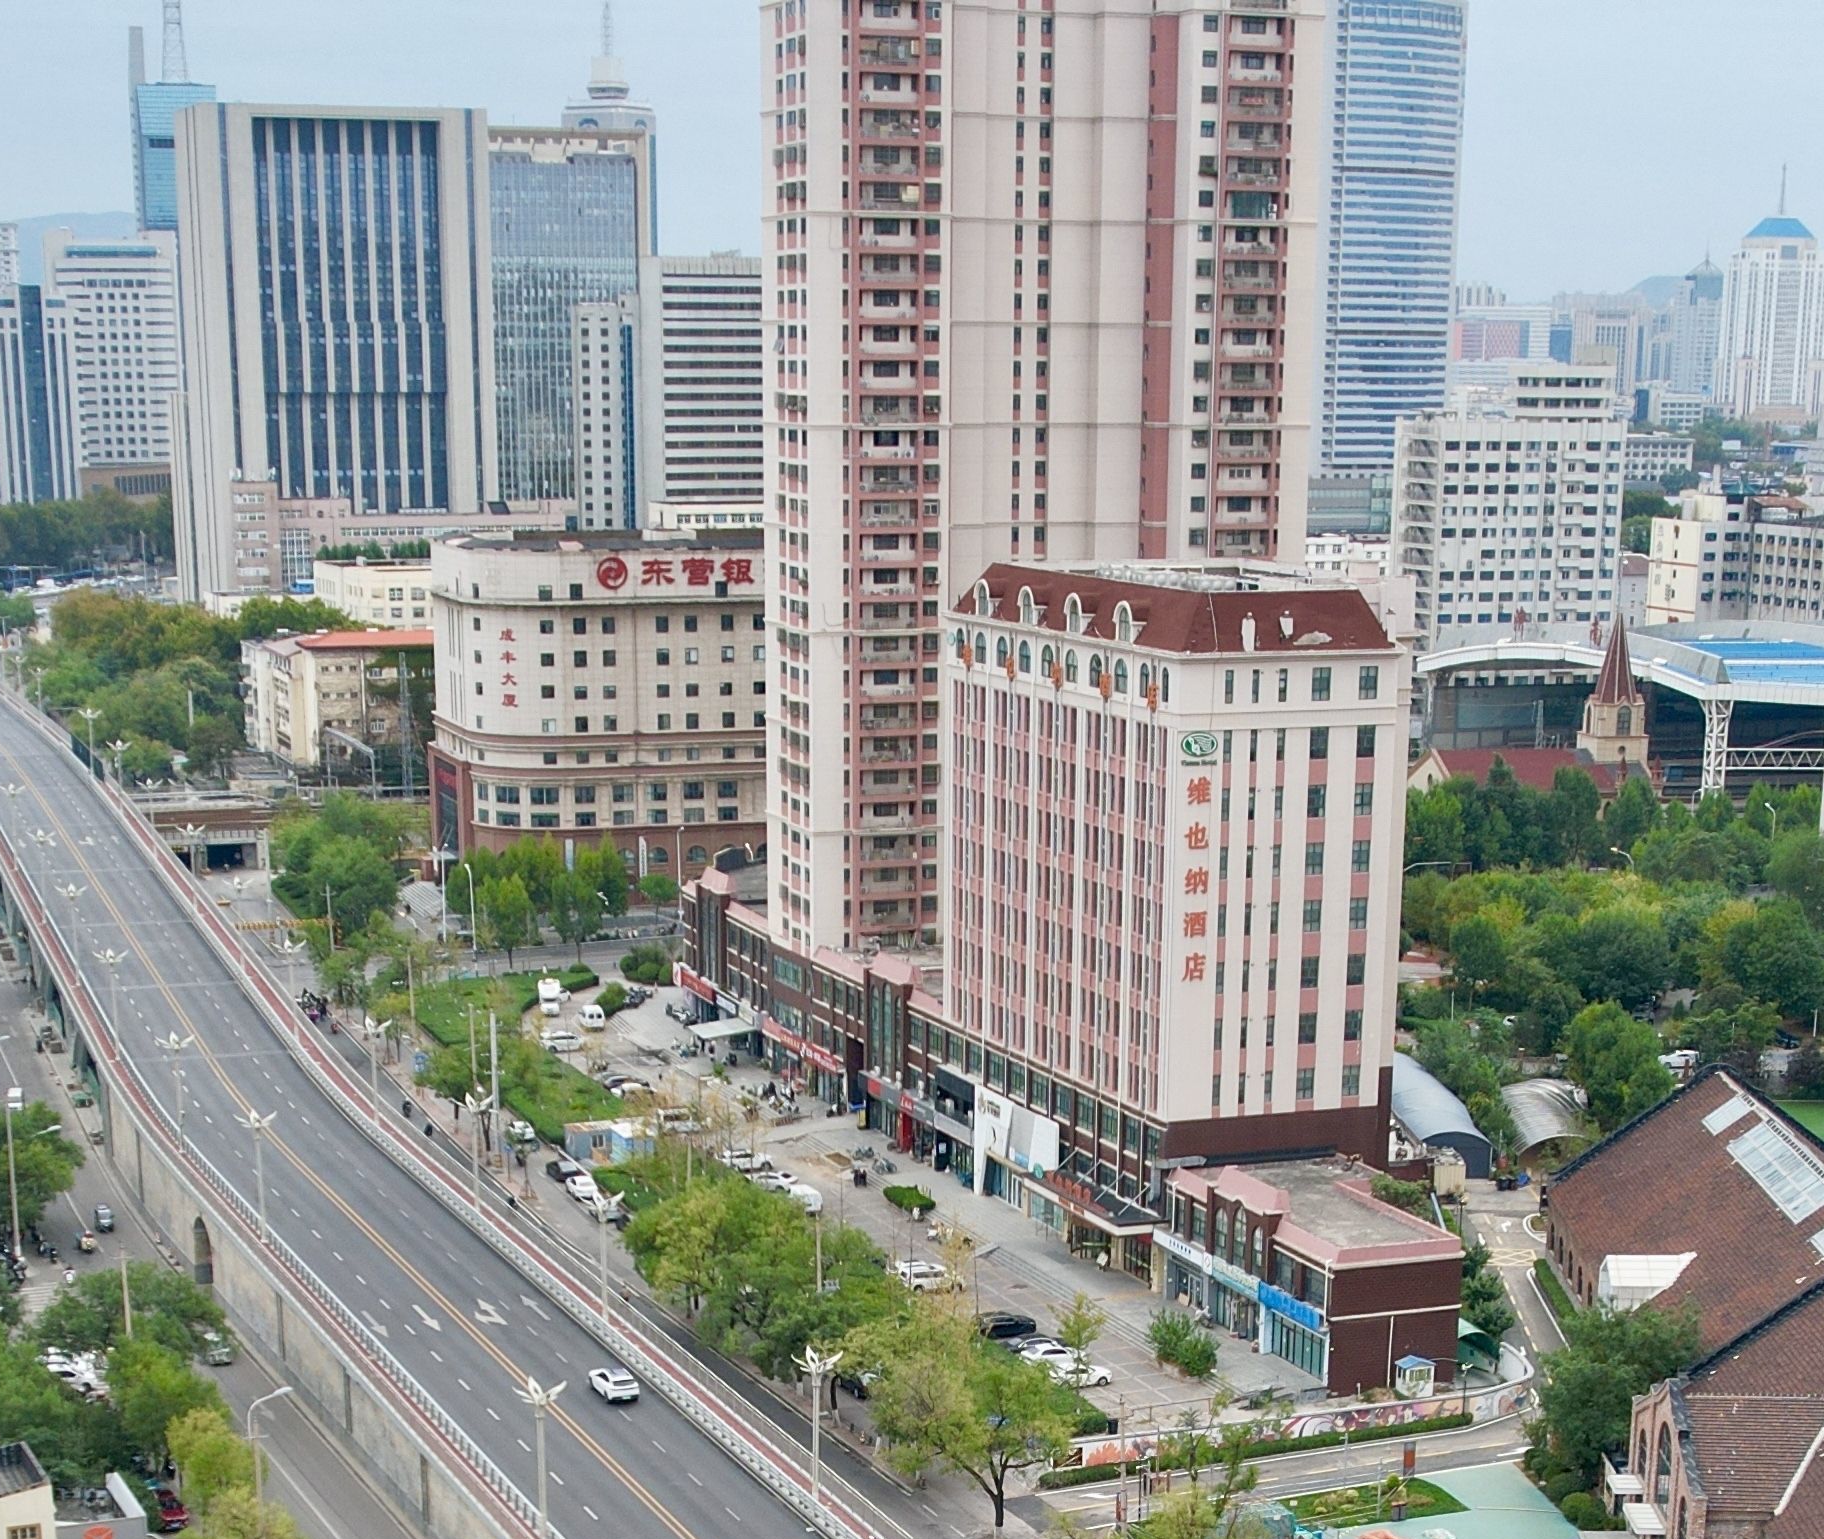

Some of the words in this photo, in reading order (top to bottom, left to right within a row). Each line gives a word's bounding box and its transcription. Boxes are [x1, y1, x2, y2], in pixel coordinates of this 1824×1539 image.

[641, 557, 755, 586] 东营银
[498, 628, 519, 708] 成丰大厦
[1181, 775, 1212, 983] 维也纳酒店
